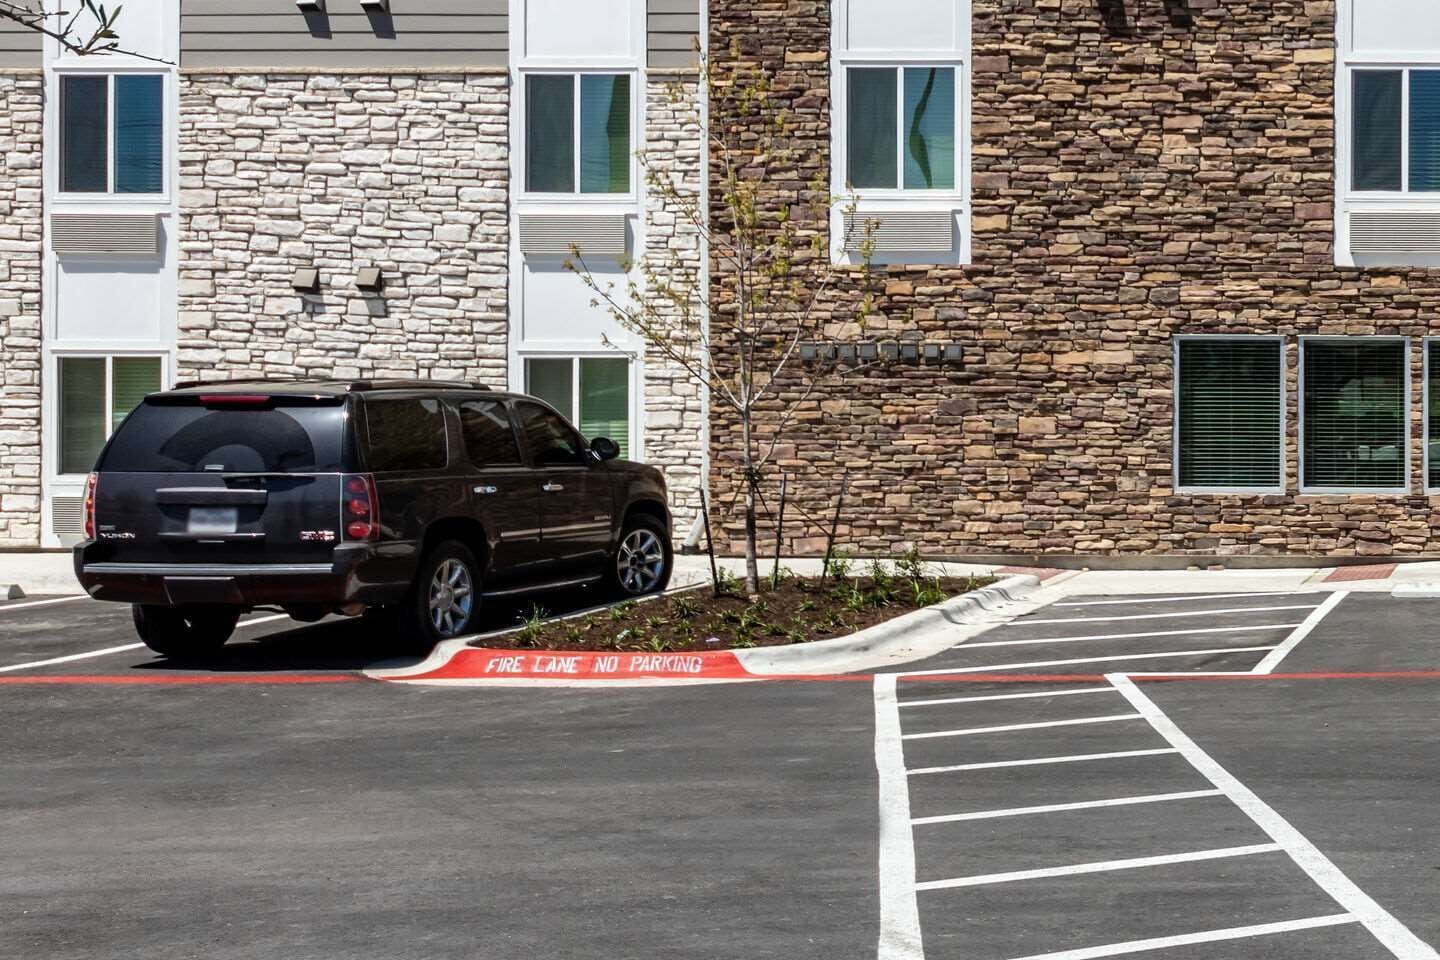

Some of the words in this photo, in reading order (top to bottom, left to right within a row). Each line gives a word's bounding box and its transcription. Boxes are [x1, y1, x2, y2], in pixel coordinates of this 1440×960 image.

[484, 655, 526, 673] FIRE
[532, 655, 583, 674] LANE
[594, 655, 619, 673] NO
[628, 655, 703, 673] PARKING
